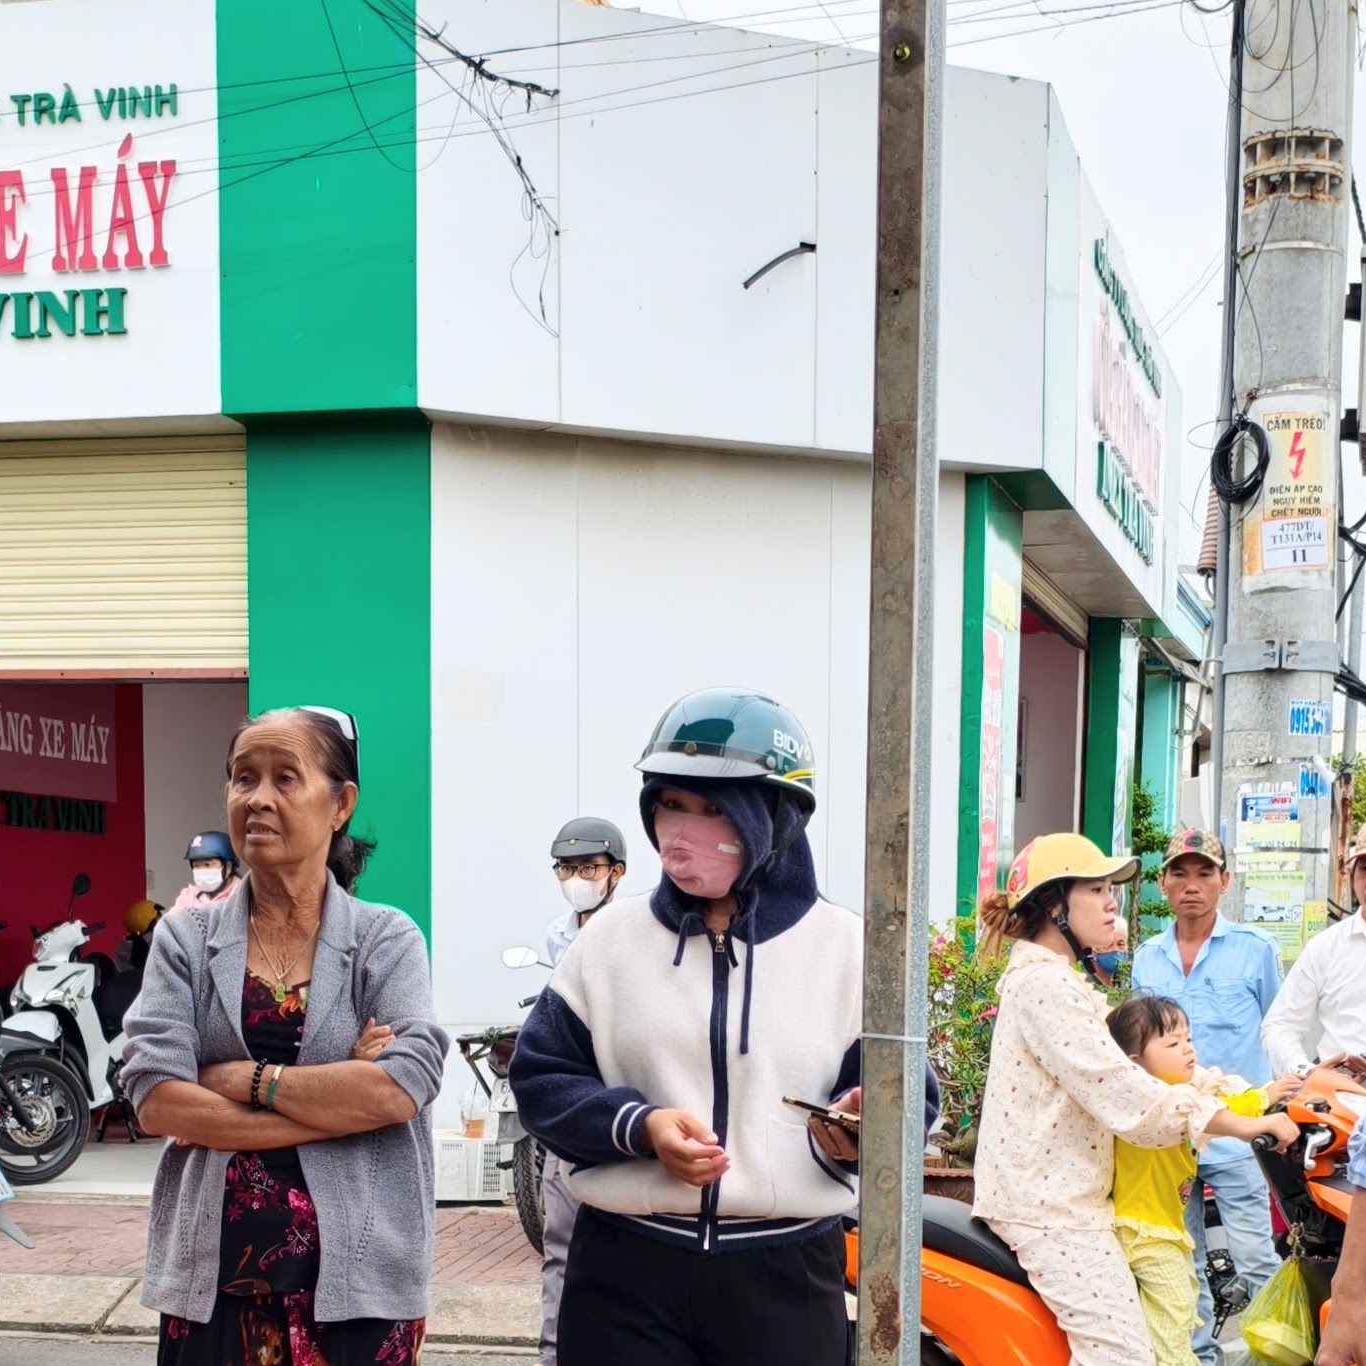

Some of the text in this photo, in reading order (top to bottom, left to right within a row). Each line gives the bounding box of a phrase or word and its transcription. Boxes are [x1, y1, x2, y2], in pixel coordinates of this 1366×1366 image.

[10, 82, 82, 127] TRÀ
[94, 83, 178, 121] VINH
[50, 132, 178, 274] MÁY
[1267, 415, 1291, 432] CẤM
[1308, 484, 1323, 495] CAO
[1291, 549, 1307, 563] 11
[39, 716, 66, 760] XE
[71, 714, 110, 765] MÁY
[773, 729, 804, 760] BIDV
[55, 798, 107, 835] VINH
